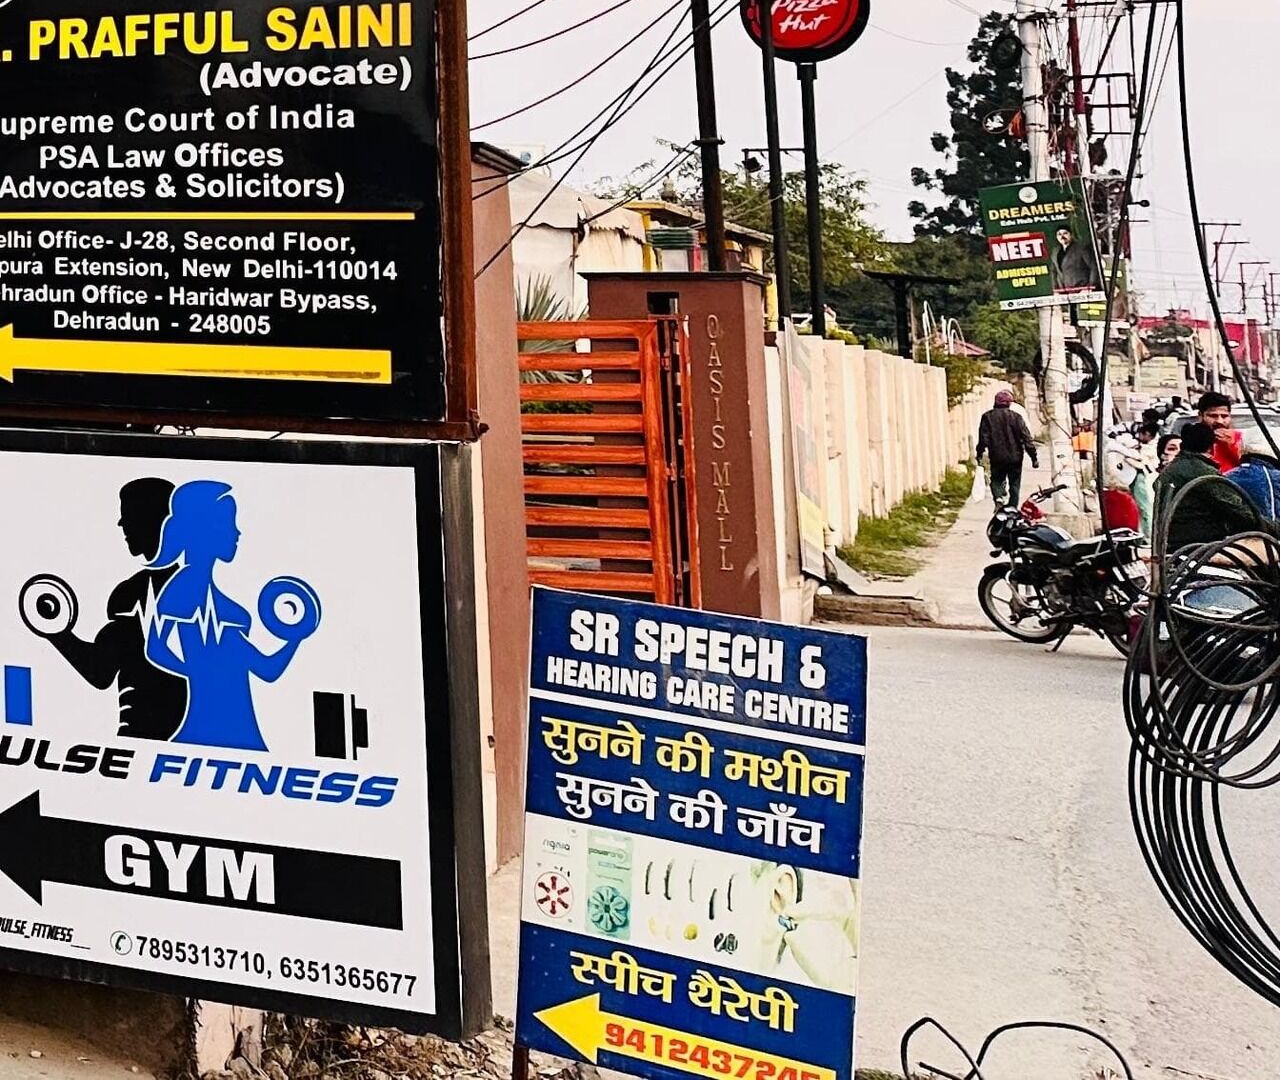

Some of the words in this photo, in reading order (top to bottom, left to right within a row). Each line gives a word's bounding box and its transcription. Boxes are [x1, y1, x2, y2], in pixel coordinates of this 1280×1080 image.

[28, 10, 250, 61] PRAFFUL
[264, 2, 413, 51] SAINI
[778, 14, 832, 34] Hut
[199, 56, 413, 97] (Advocate)
[123, 107, 216, 133] Court
[224, 105, 259, 130] of
[269, 102, 356, 131] India
[39, 145, 100, 170] PSA
[106, 145, 166, 169] Law
[173, 142, 285, 169] Offices
[154, 173, 177, 198] &
[185, 171, 346, 205] Solicitors)
[988, 201, 1076, 221] DREAMERS
[119, 232, 176, 255] J-28,
[182, 232, 276, 253] Second
[282, 232, 357, 256] Floor,
[991, 239, 1044, 262] NEET
[53, 257, 171, 281] Extension,
[181, 258, 232, 280] New
[242, 258, 399, 282] Delhi-110014
[996, 265, 1049, 279] ADMISSION
[1011, 277, 1037, 288] OPEN
[81, 284, 149, 306] Office
[168, 286, 274, 308] Haridwar
[279, 289, 378, 314] Bypass,
[52, 310, 161, 333] Dehradun
[188, 314, 272, 336] 248005
[711, 461, 734, 571] MALL
[568, 608, 620, 657] SR
[633, 618, 785, 682] SPEECH
[546, 655, 658, 701] HEARING
[666, 674, 736, 714] CARE
[744, 688, 850, 734] CENTRE
[541, 714, 646, 766] सुनने
[655, 731, 715, 779] की
[723, 747, 851, 804] मशीन
[147, 753, 399, 809] FITNESS
[555, 771, 660, 820] सुनने
[668, 788, 728, 836] की
[737, 802, 826, 854] जाँच
[103, 834, 276, 906] GYM
[135, 934, 274, 980] 7895313710,
[279, 956, 418, 998] 6351365677
[569, 948, 677, 1004] स्पीच
